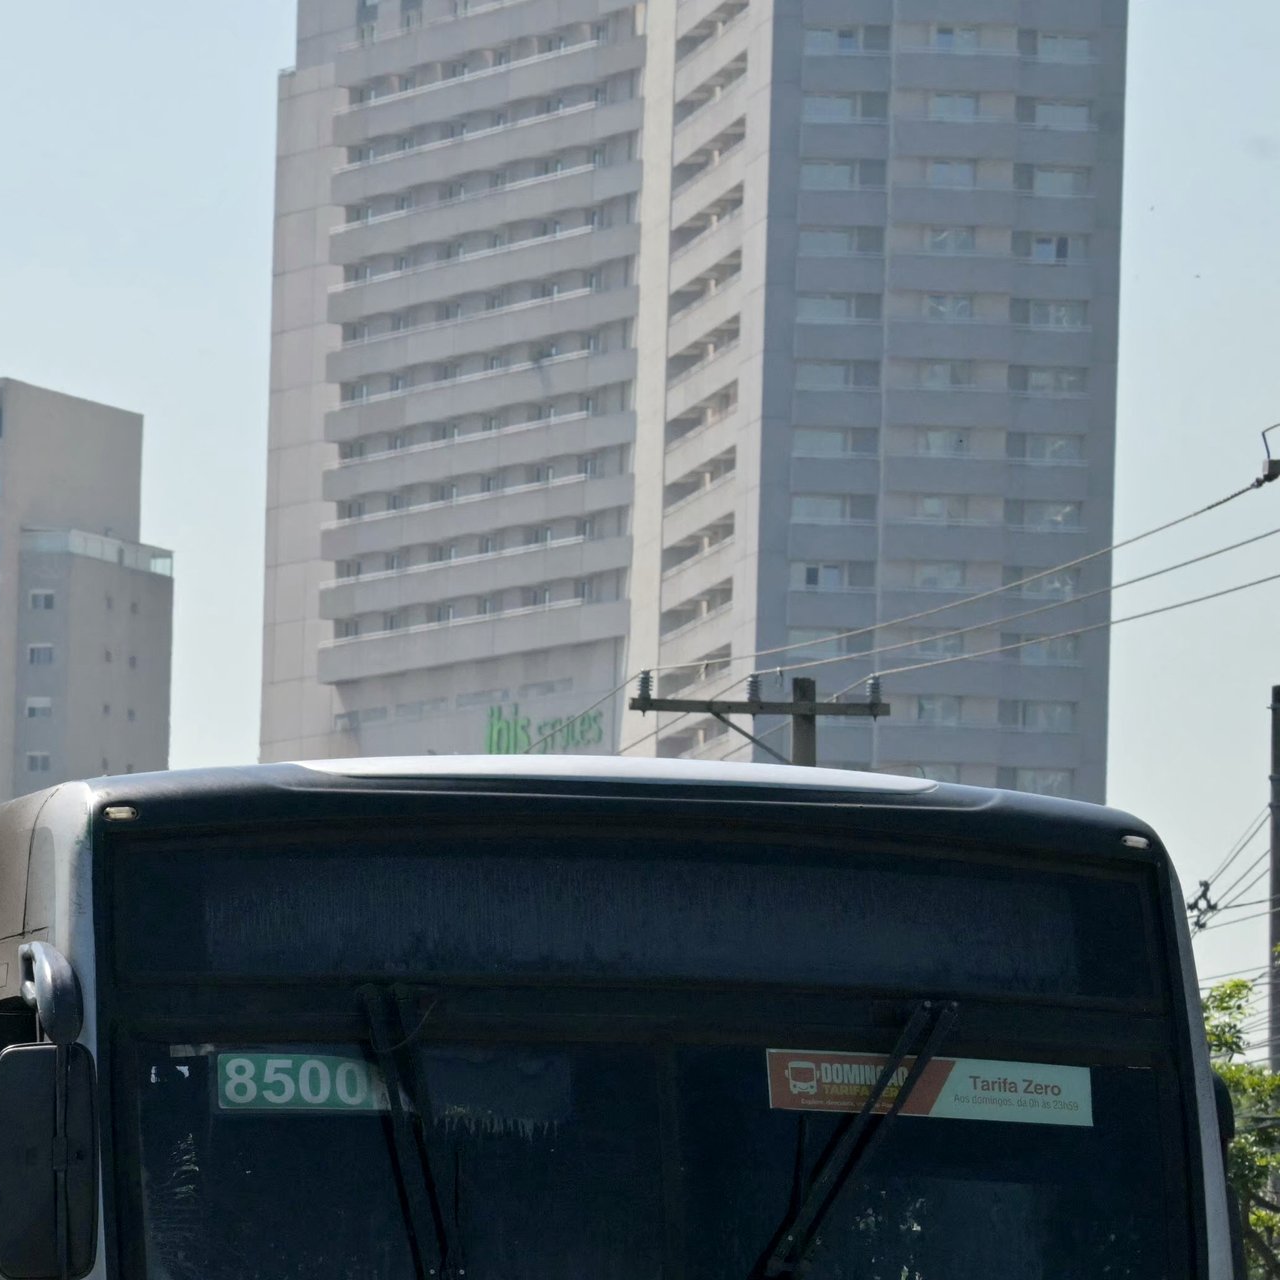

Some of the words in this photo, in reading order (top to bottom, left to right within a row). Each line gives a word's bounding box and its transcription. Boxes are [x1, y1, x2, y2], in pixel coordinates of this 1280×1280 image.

[224, 1058, 369, 1105] 8500
[969, 1075, 1018, 1093] Tarifa
[1022, 1079, 1062, 1097] Zero
[954, 1094, 970, 1104] Aos
